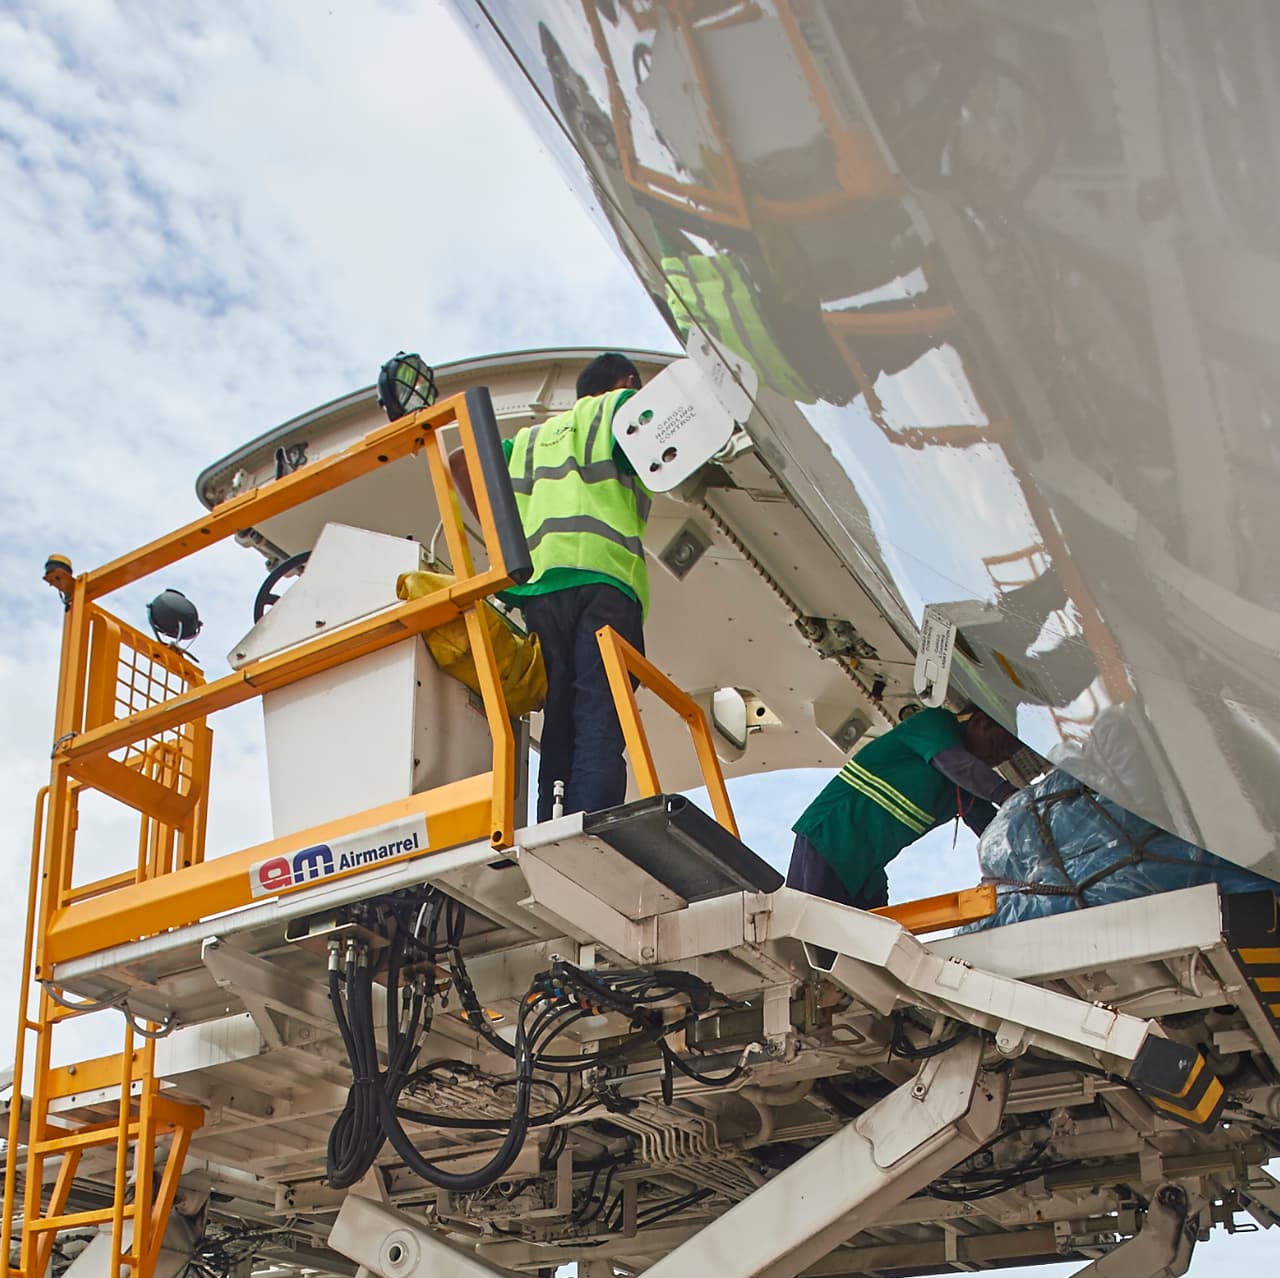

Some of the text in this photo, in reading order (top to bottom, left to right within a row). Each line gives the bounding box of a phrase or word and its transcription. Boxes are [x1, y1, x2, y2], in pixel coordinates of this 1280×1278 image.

[655, 405, 693, 439] HANDLING
[656, 406, 684, 430] CARGO
[659, 411, 696, 444] CONTROL
[339, 832, 419, 870] Airmarrel
